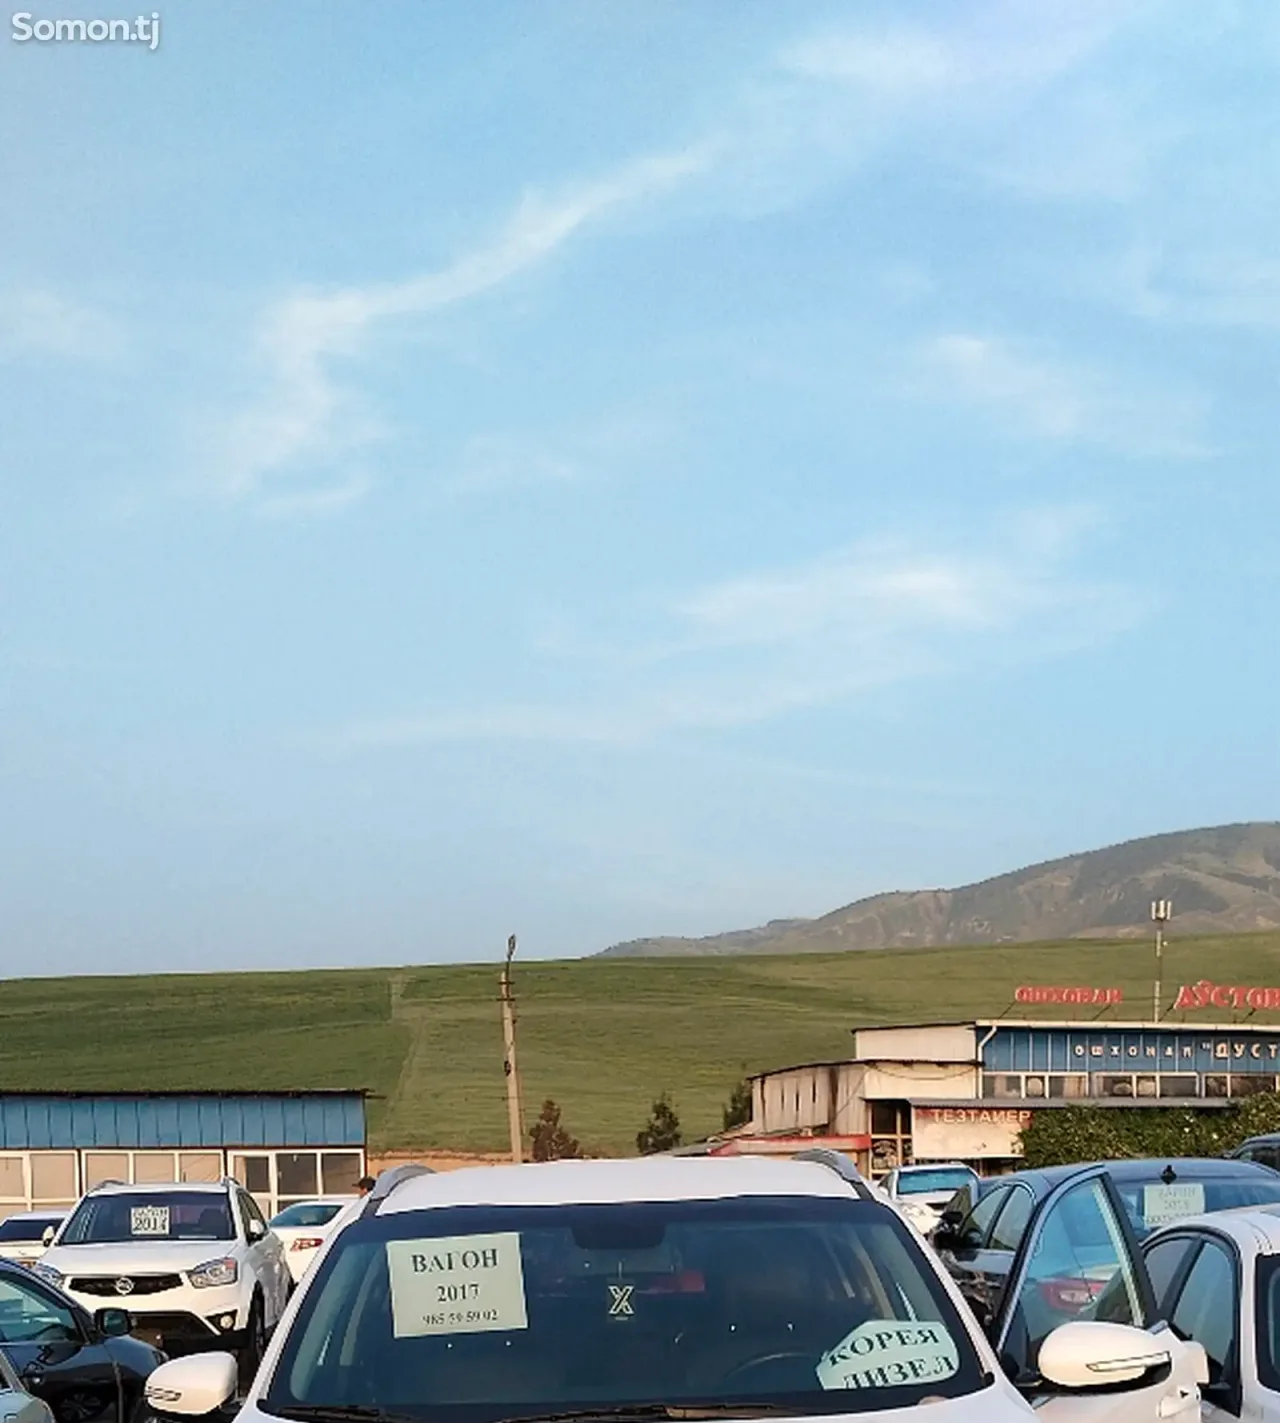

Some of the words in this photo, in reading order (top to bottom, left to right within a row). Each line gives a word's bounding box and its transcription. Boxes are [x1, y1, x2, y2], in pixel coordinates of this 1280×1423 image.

[411, 1248, 499, 1274] ВАГОН
[437, 1283, 480, 1302] 2017
[829, 1329, 940, 1367] КОРЕЯ
